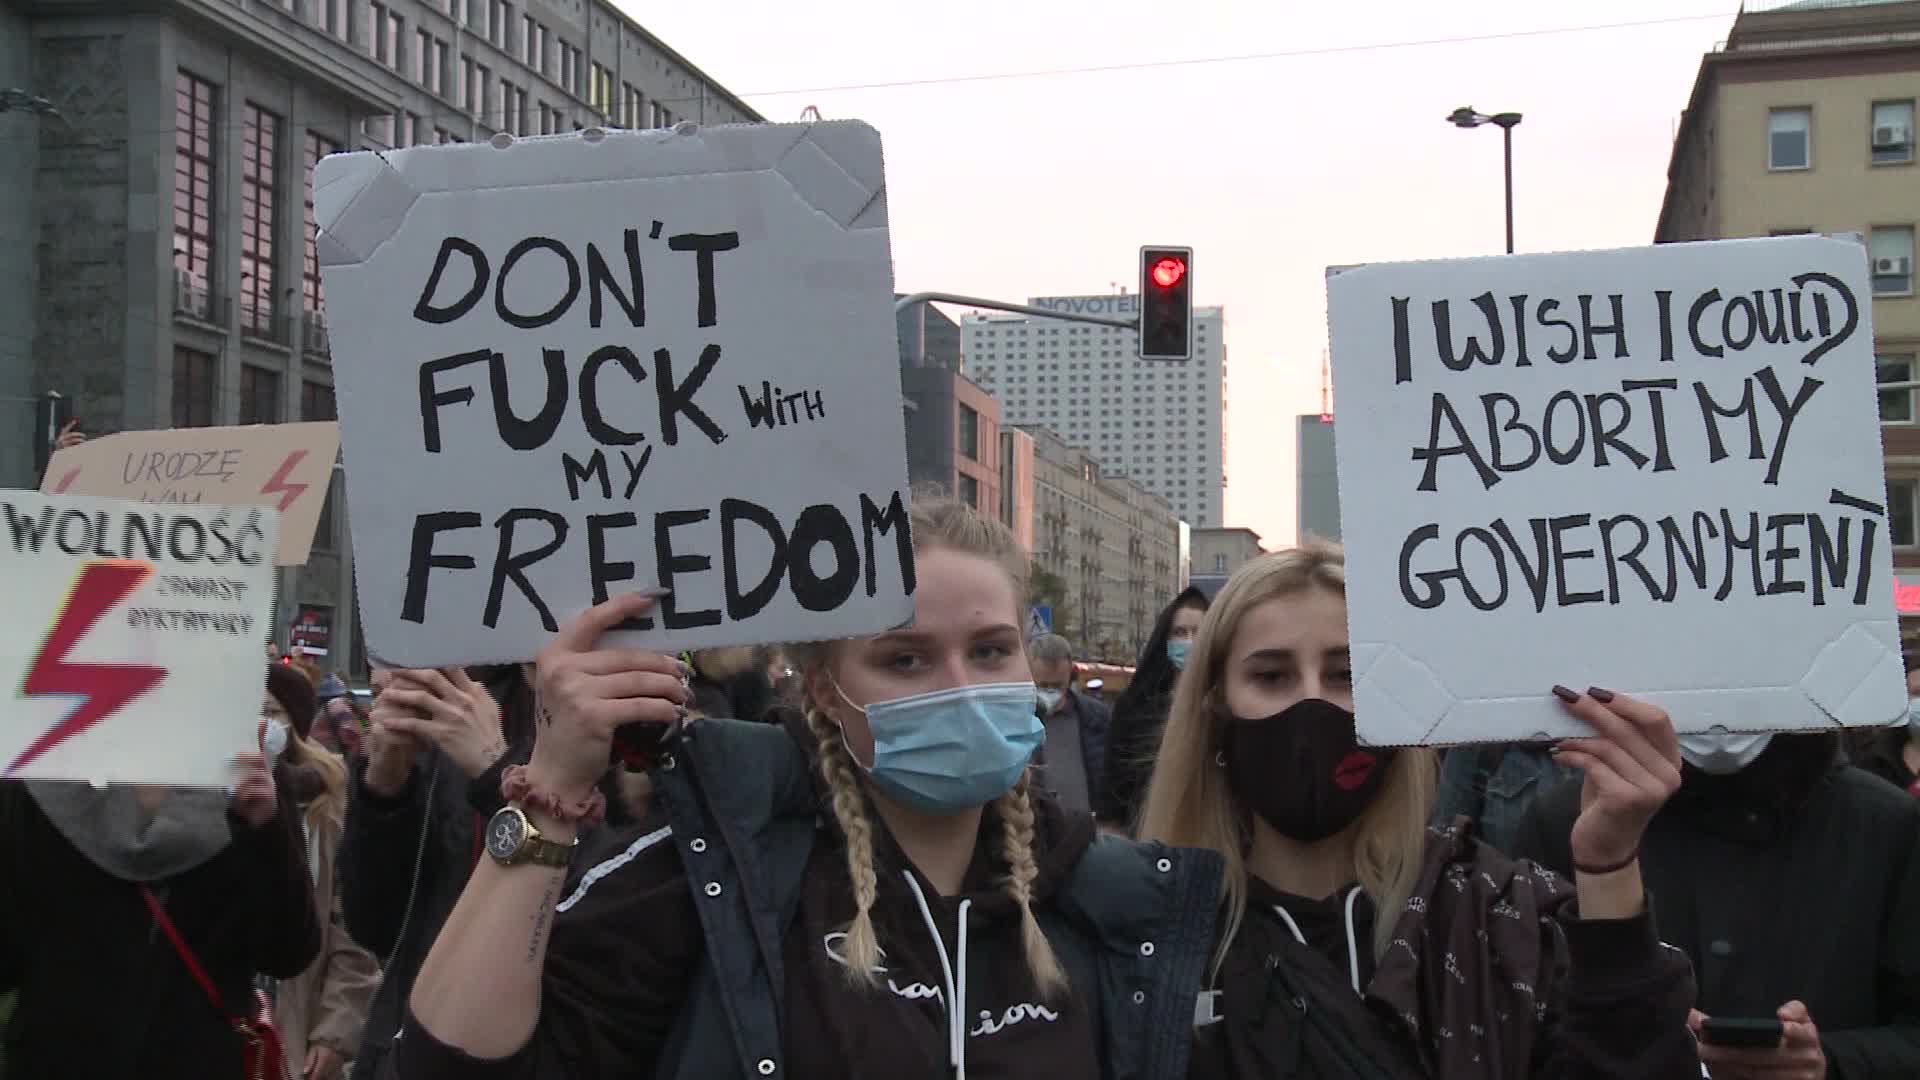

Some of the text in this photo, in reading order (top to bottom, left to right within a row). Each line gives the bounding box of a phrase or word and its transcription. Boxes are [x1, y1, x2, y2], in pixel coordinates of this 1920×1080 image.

[413, 220, 740, 329] DON'T
[1391, 273, 1859, 384] I WISH I COULD
[419, 344, 729, 453] FUCK
[1411, 366, 1825, 492] ABORT MY
[123, 449, 242, 483] URODZĘ
[562, 445, 652, 501] MY
[3, 502, 265, 566] WOLNOŚĆ
[400, 491, 915, 632] FREEDOM
[1399, 488, 1885, 613] GOVERNMENT
